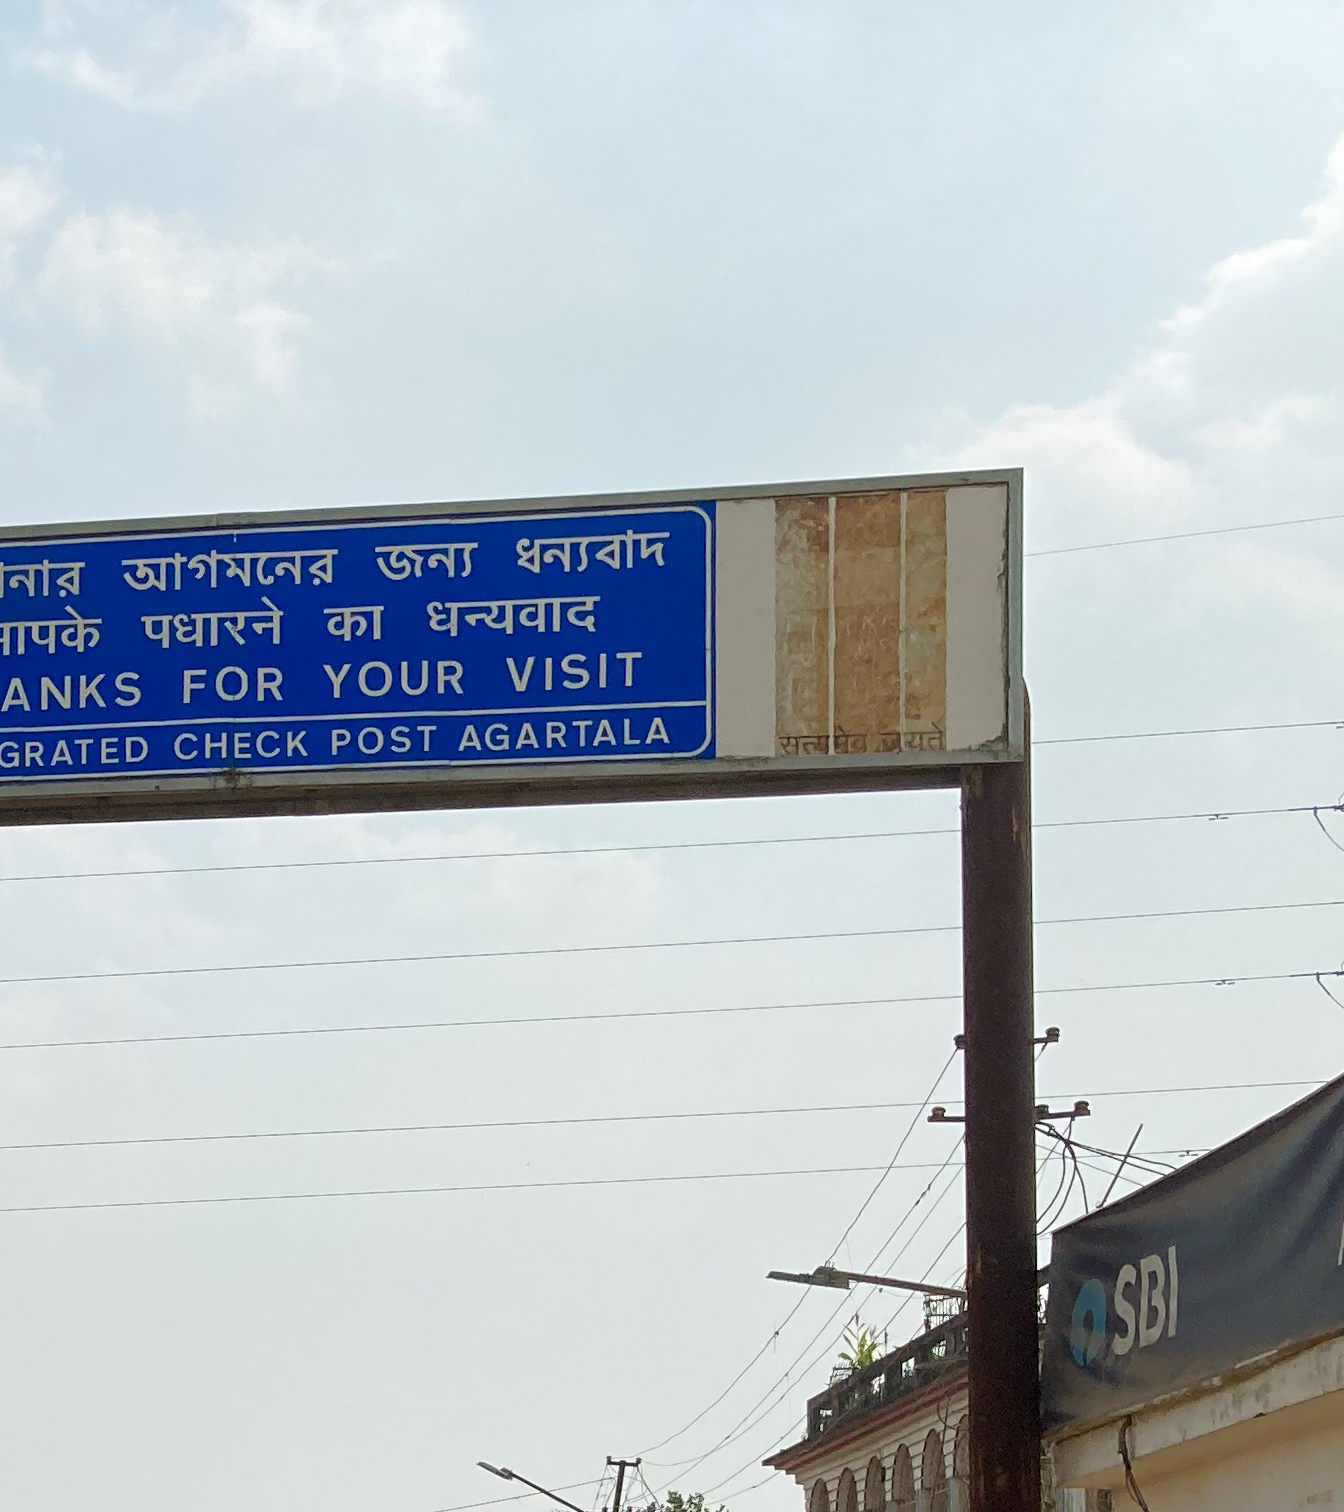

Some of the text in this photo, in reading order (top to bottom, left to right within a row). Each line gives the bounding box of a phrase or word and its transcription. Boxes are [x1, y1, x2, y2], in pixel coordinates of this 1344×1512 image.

[121, 549, 339, 592] আগমনের
[374, 541, 479, 579] জন্য
[515, 529, 671, 574] ধন্যবাদ
[141, 597, 284, 649] पधारने
[323, 605, 385, 642] का
[426, 595, 601, 637] धन्यवाद
[182, 667, 284, 704] FOR
[323, 659, 465, 698] YOUR
[505, 651, 643, 693] VISIT
[173, 730, 309, 763] CHECK
[330, 725, 437, 756] POST
[458, 715, 671, 752] AGARTALA
[1111, 1245, 1179, 1357] SBI
